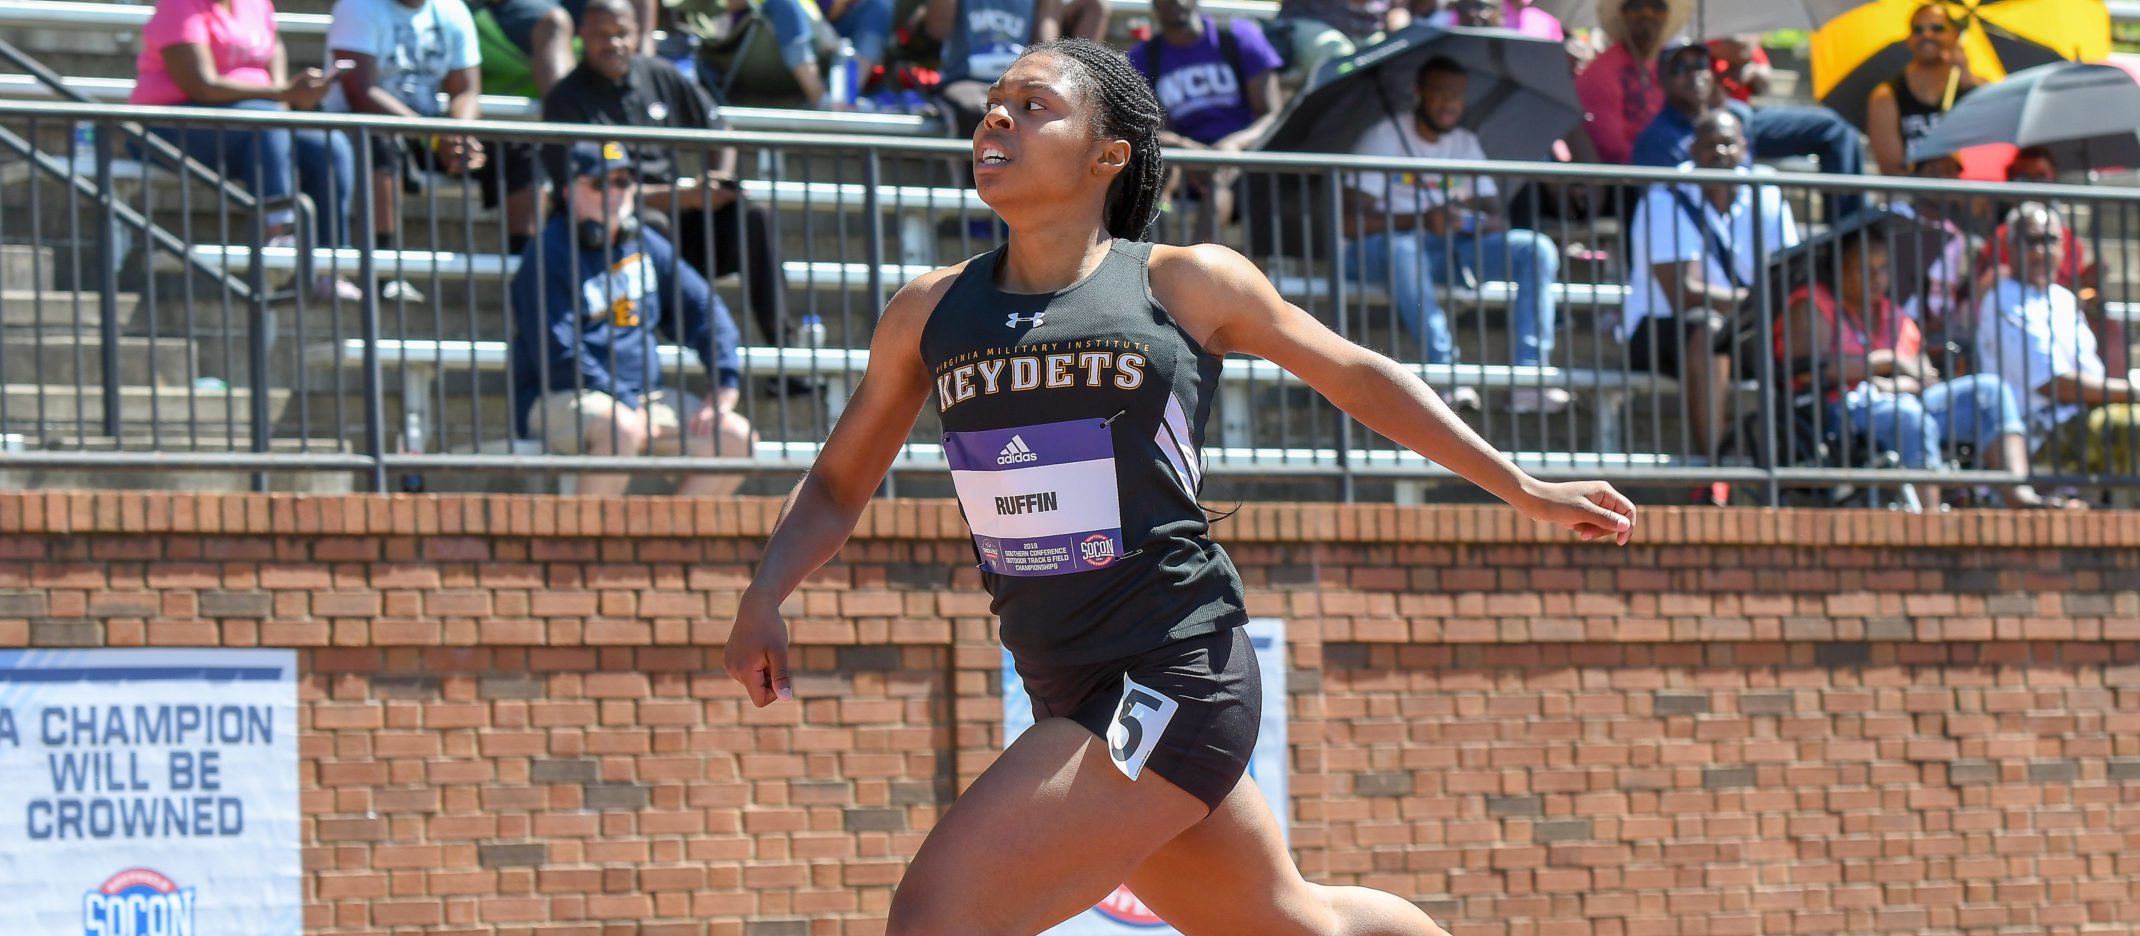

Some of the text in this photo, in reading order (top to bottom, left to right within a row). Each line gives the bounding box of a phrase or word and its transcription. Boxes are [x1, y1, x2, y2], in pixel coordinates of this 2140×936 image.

[936, 339, 1150, 374] VIRGINIA MILITARY INSTITUTE
[936, 352, 1146, 413] KEYDETS
[996, 451, 1038, 465] adidas
[994, 491, 1058, 516] RUFFIN
[1027, 556, 1047, 564] TRACK
[1052, 554, 1069, 562] FIELD
[1029, 547, 1068, 556] CONFERENCE
[1080, 538, 1115, 560] SOCON
[1015, 563, 1058, 571] CHAMPIONSHIPS
[41, 704, 273, 747] CHAMPION
[1111, 688, 1164, 762] 5
[49, 751, 221, 793] WILL BE
[27, 797, 243, 840] CROWNED
